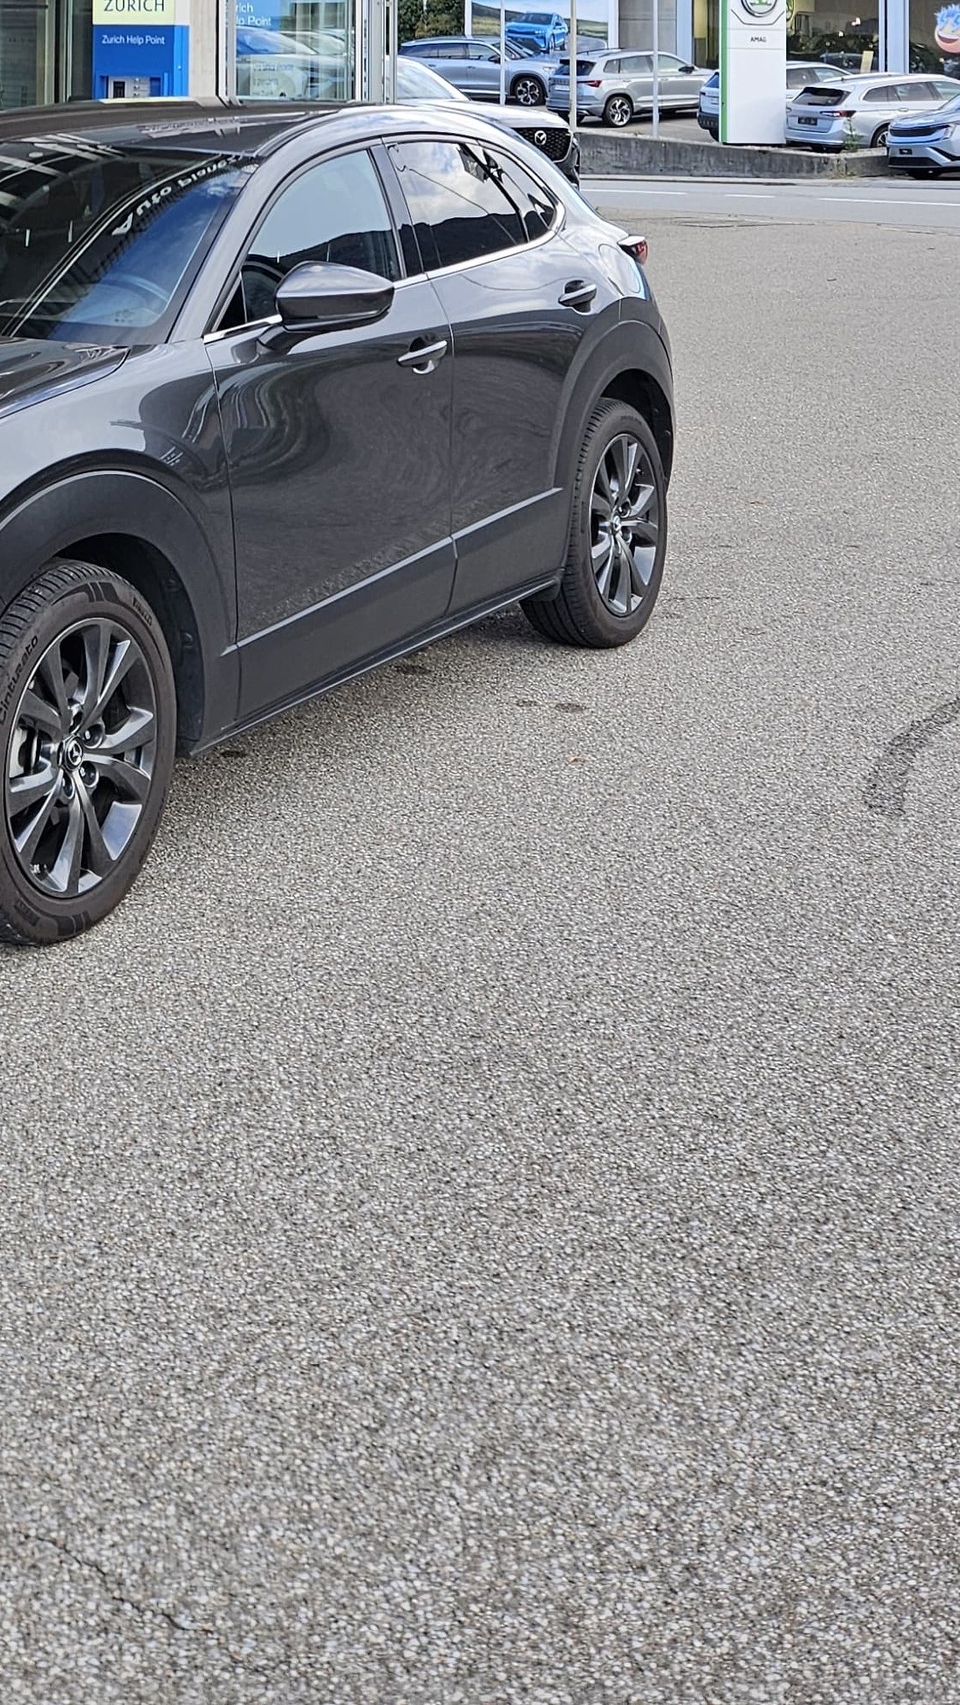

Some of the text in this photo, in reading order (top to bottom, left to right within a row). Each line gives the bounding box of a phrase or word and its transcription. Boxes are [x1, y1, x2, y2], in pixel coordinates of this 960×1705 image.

[236, 2, 253, 13] rich
[247, 15, 271, 26] Point
[102, 34, 165, 45] Zurich Help Point
